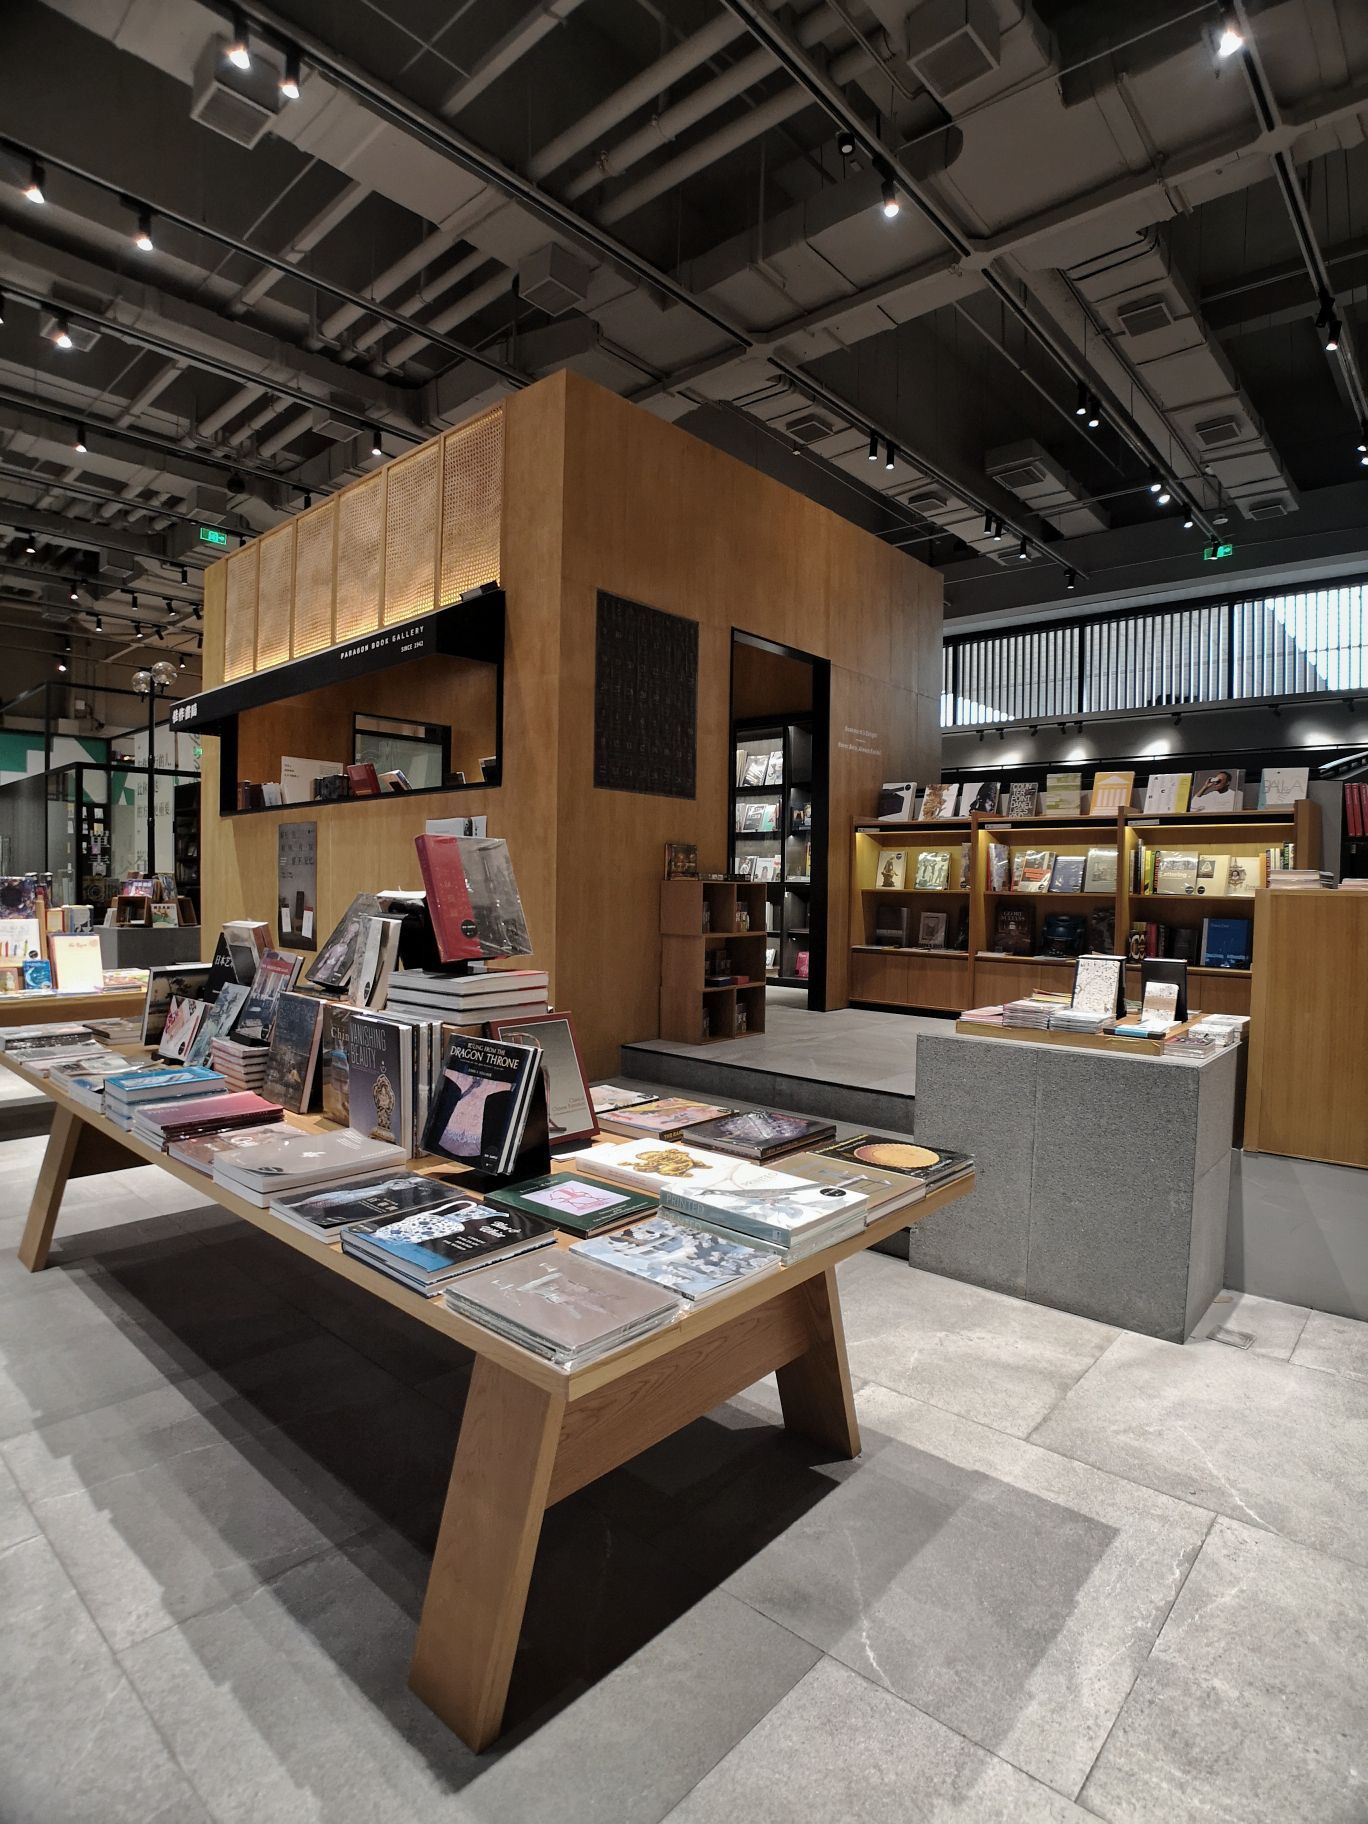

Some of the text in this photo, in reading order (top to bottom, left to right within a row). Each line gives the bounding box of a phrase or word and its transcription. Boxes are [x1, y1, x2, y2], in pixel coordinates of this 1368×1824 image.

[340, 626, 424, 660] PARAGON BOOK GALLERY
[400, 643, 413, 653] SINCE
[330, 1026, 350, 1042] Chin
[350, 1023, 387, 1051] VANISHING
[350, 1043, 376, 1069] BEAUTY
[450, 1045, 484, 1062] DRAGON
[486, 1053, 520, 1070] THRONE
[665, 1192, 705, 1215] PRINTED
